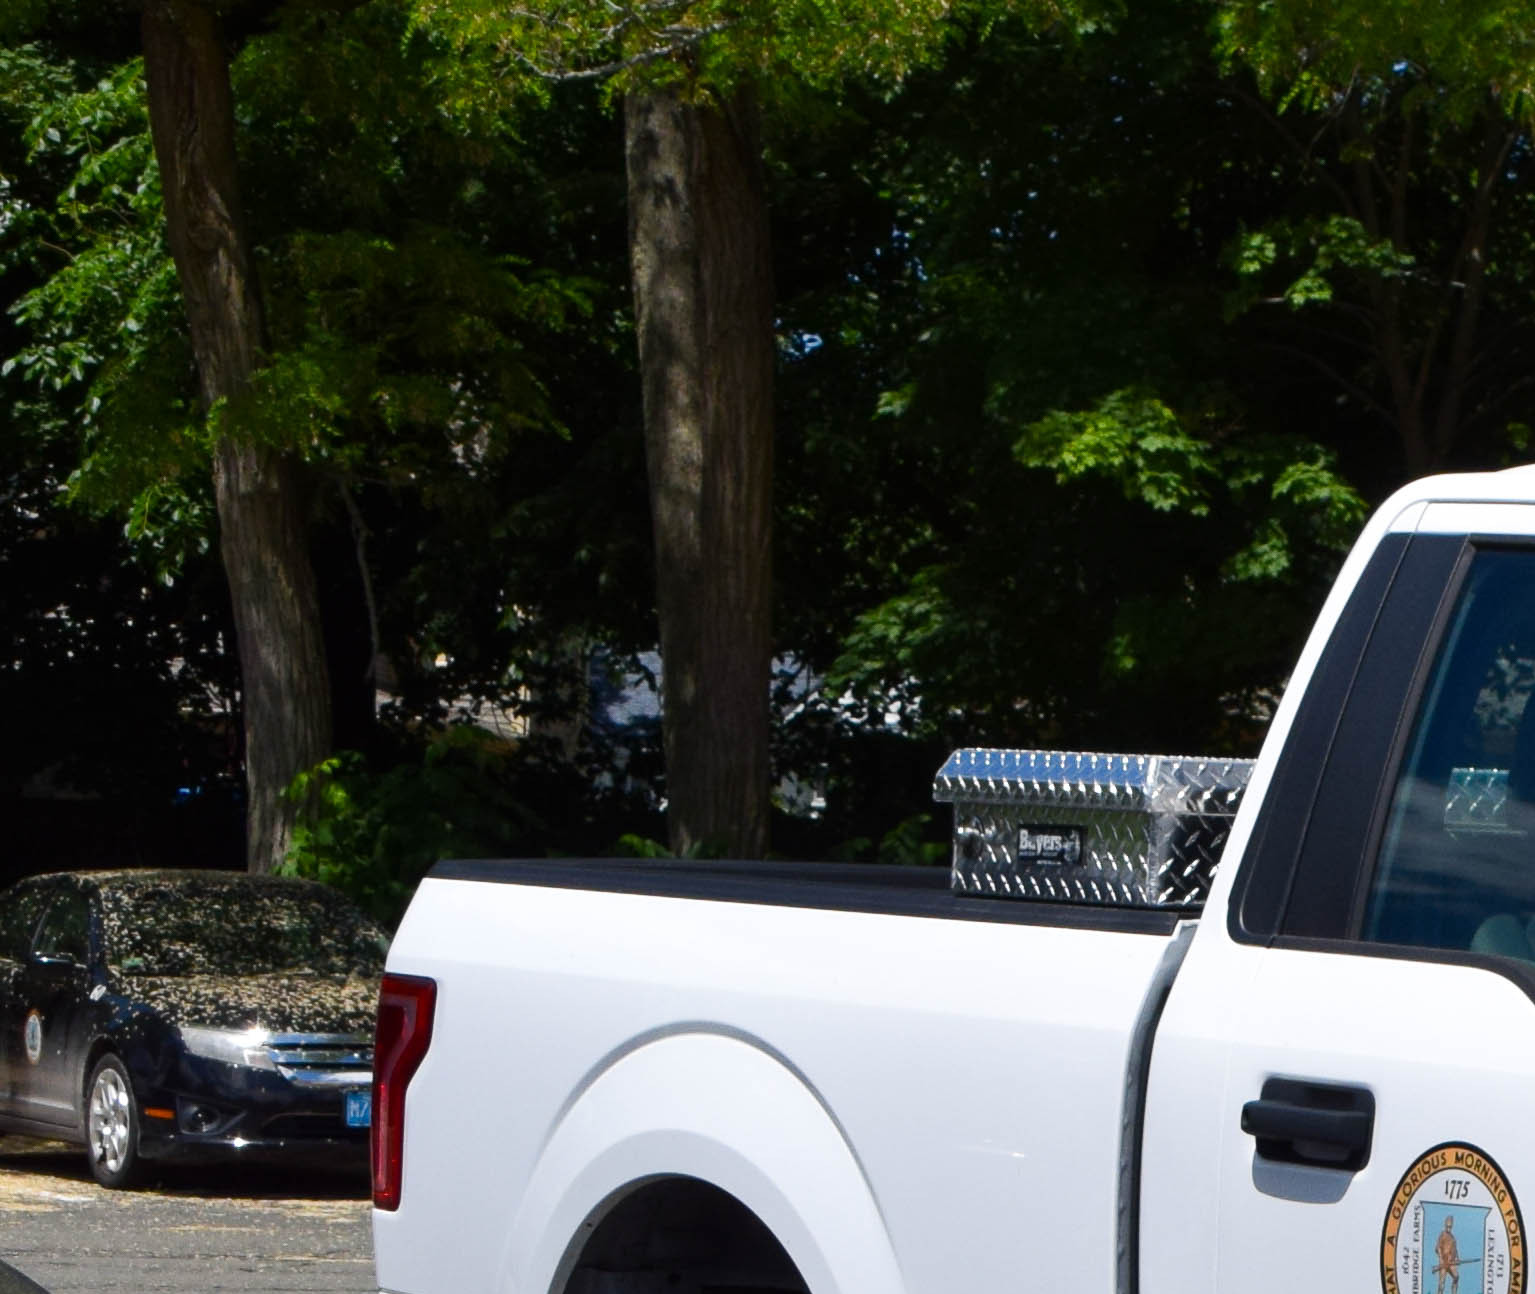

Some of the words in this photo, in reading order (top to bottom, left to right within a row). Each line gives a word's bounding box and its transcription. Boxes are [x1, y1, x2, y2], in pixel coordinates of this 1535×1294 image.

[1391, 1152, 1447, 1220] GLORIOUS
[1444, 1179, 1471, 1200] 1775
[1454, 1151, 1507, 1202] MORNING
[1386, 1234, 1397, 1248] A
[1412, 1205, 1422, 1242] FARMS
[1505, 1207, 1521, 1247] FOR
